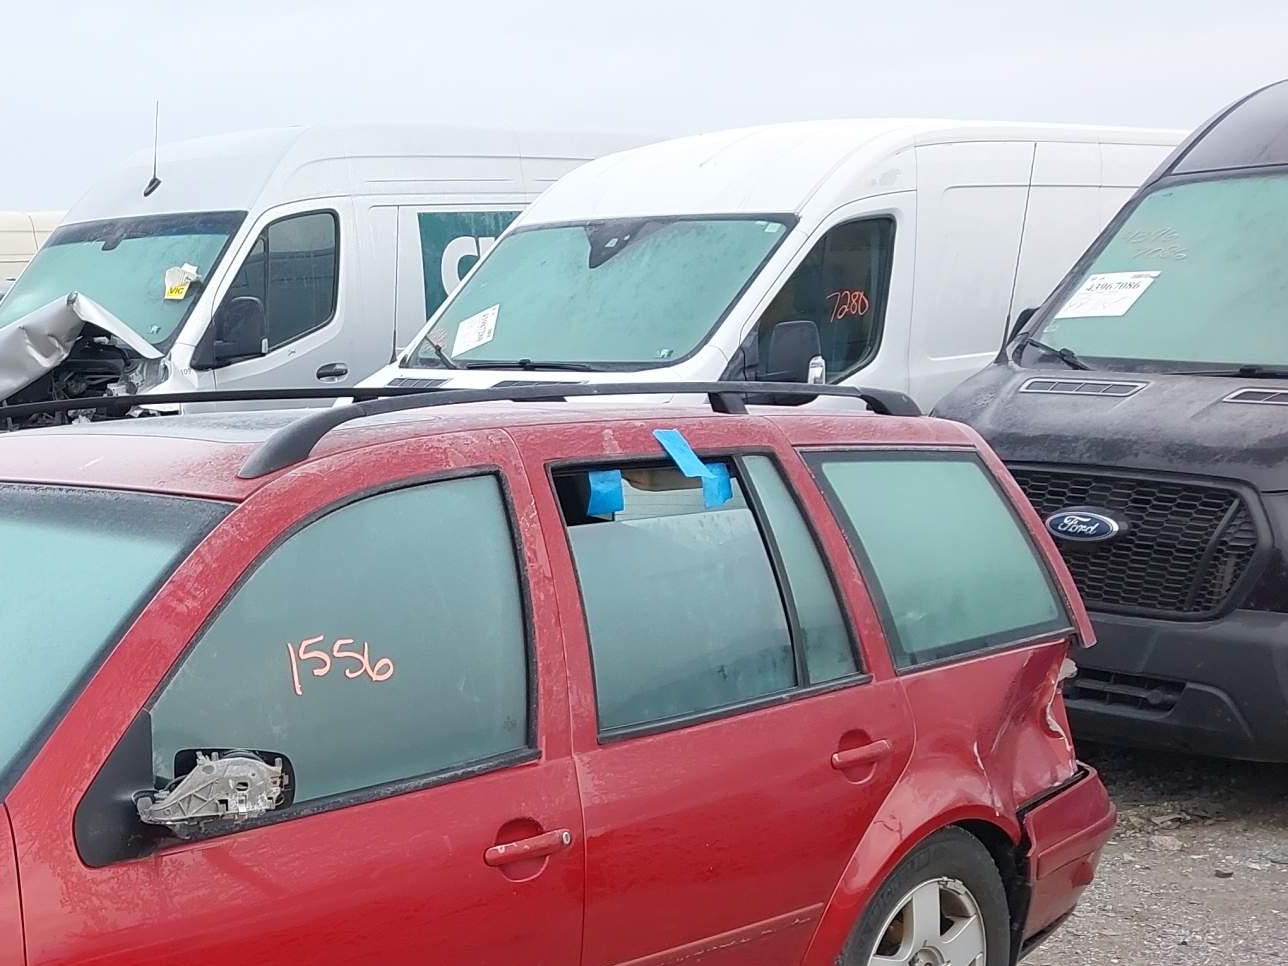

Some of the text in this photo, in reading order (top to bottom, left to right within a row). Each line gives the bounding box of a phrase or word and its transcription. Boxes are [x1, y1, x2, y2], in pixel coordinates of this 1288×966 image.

[826, 290, 870, 323] 7280
[1058, 516, 1100, 535] Ford
[287, 635, 394, 695] 1556
